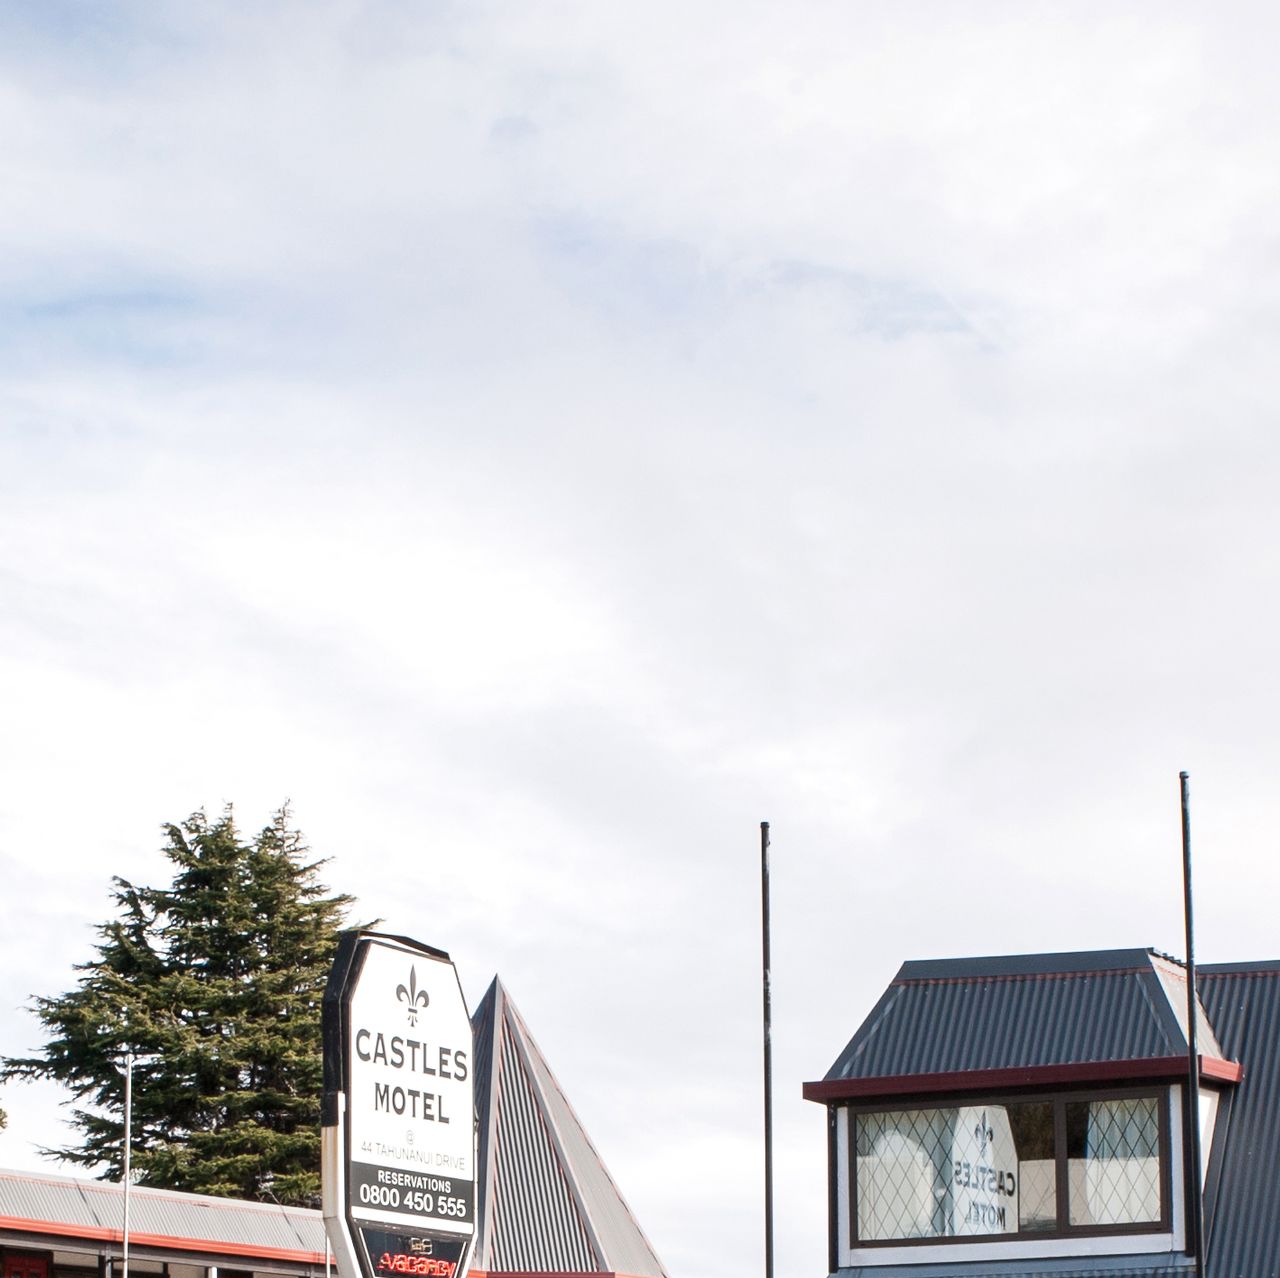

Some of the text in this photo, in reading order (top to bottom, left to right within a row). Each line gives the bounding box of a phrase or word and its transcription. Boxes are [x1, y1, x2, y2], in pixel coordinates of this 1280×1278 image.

[355, 1028, 468, 1081] CASTLES
[374, 1082, 449, 1124] MOTEL
[406, 1129, 415, 1145] @
[361, 1140, 465, 1171] 44 TAHUNANUI DRIVE
[377, 1170, 452, 1194] RESERVATIONS
[360, 1183, 467, 1218] 0800 450 555
